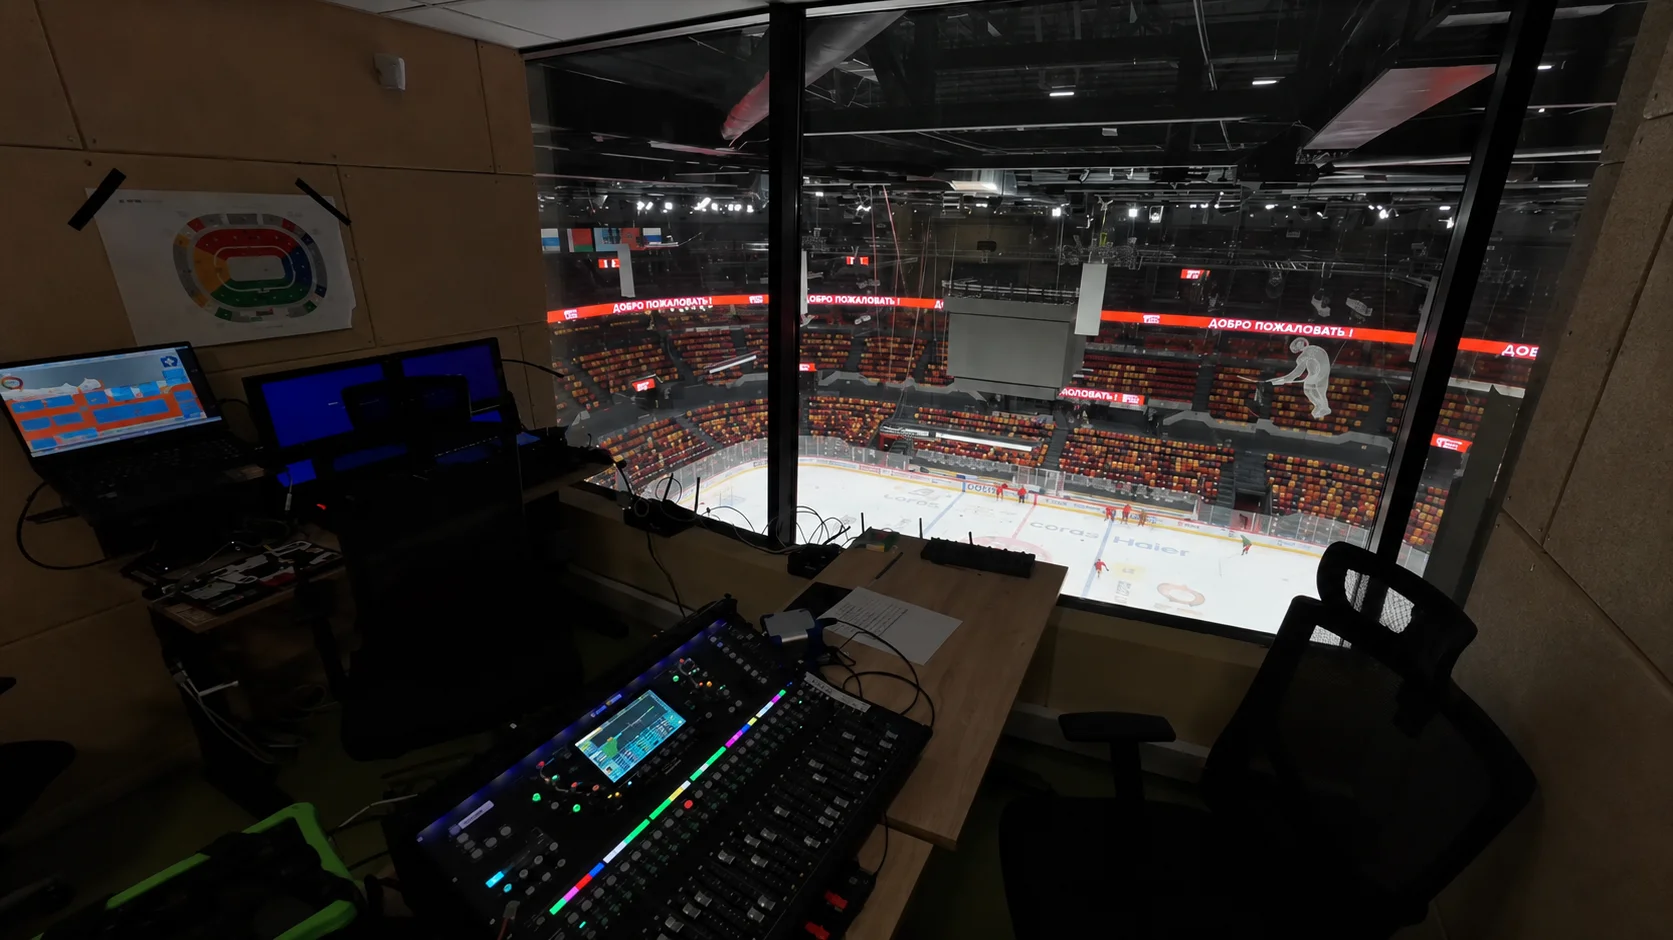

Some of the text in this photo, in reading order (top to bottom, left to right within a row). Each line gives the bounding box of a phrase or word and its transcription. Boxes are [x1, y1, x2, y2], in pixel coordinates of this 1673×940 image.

[612, 301, 644, 314] ДОБРО
[806, 295, 833, 304] ОБРО
[1208, 318, 1252, 330] ДОБРО
[1255, 321, 1346, 337] ПОЖАЛОВАТЬ
[1112, 535, 1190, 557] Haier
